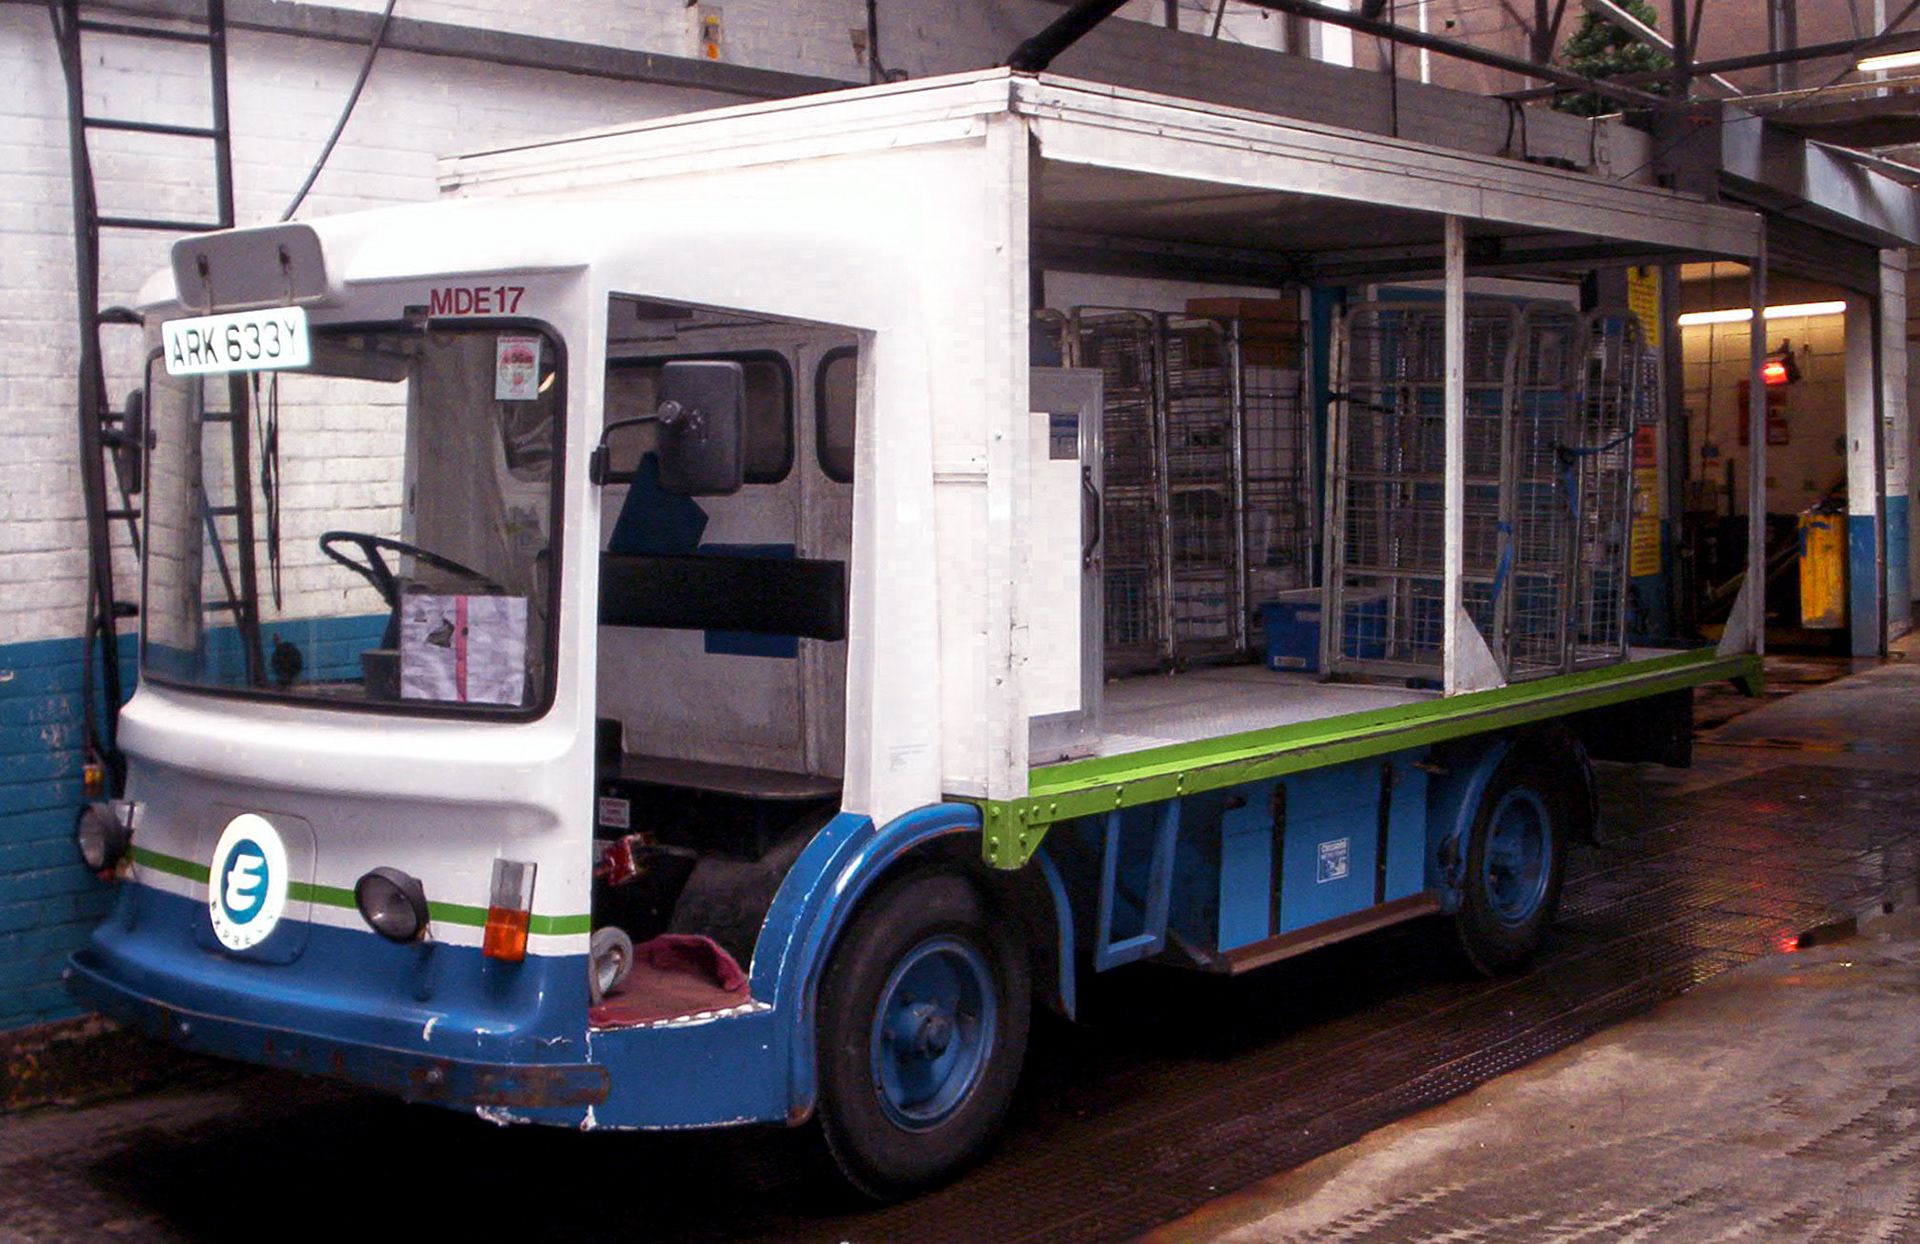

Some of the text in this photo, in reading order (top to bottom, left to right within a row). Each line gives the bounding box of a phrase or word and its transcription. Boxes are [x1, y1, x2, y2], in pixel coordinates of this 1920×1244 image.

[430, 286, 525, 315] MDE17
[172, 319, 297, 367] ARK 633Y
